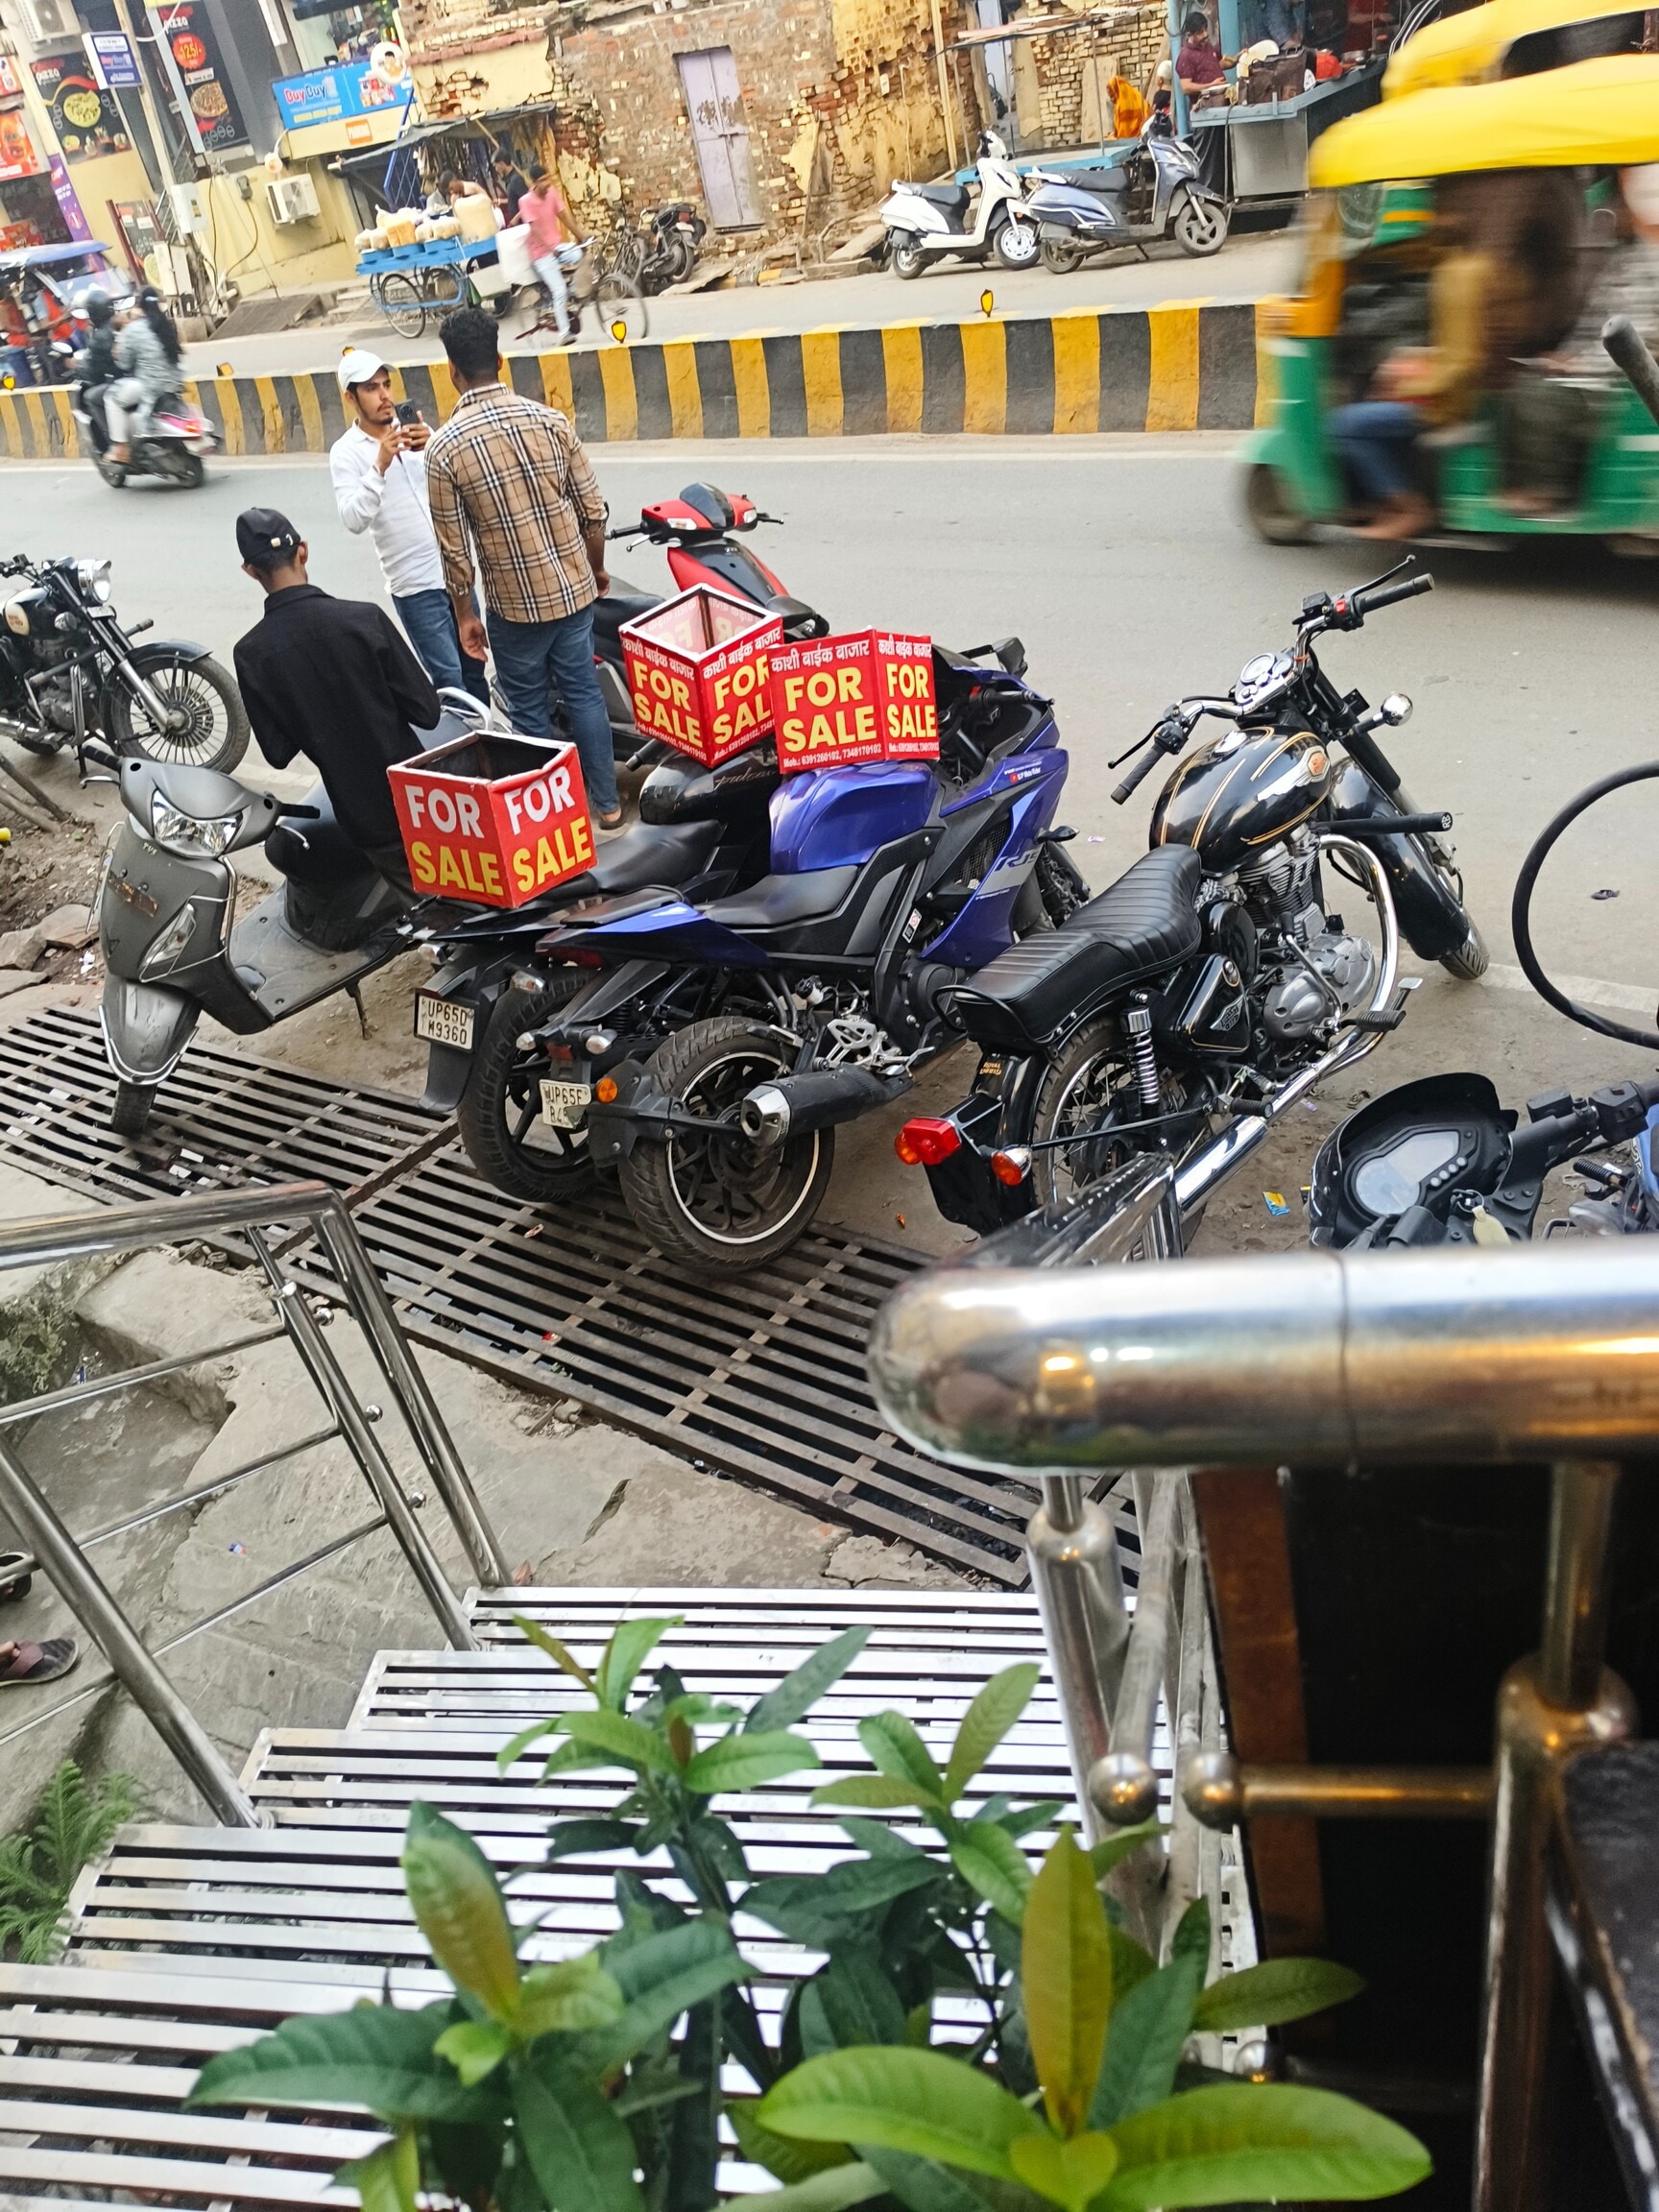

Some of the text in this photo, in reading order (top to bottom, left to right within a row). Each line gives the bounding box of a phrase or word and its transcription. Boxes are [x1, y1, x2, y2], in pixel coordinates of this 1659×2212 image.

[284, 88, 305, 105] Buy
[305, 84, 325, 99] Buy
[703, 652, 727, 679] काशी
[771, 639, 870, 672] काशी बाईक बाजार
[634, 660, 691, 711] FOR
[784, 666, 863, 712] FOR
[886, 662, 929, 698] FOR
[634, 692, 703, 748] SALE
[712, 692, 771, 744] SAL
[782, 705, 877, 753] SALE
[887, 703, 937, 738] SALE
[404, 784, 485, 839] FOR
[504, 765, 575, 836] FOR
[411, 841, 504, 896] SALE
[513, 816, 592, 893] SALE
[428, 999, 468, 1026] UP65D
